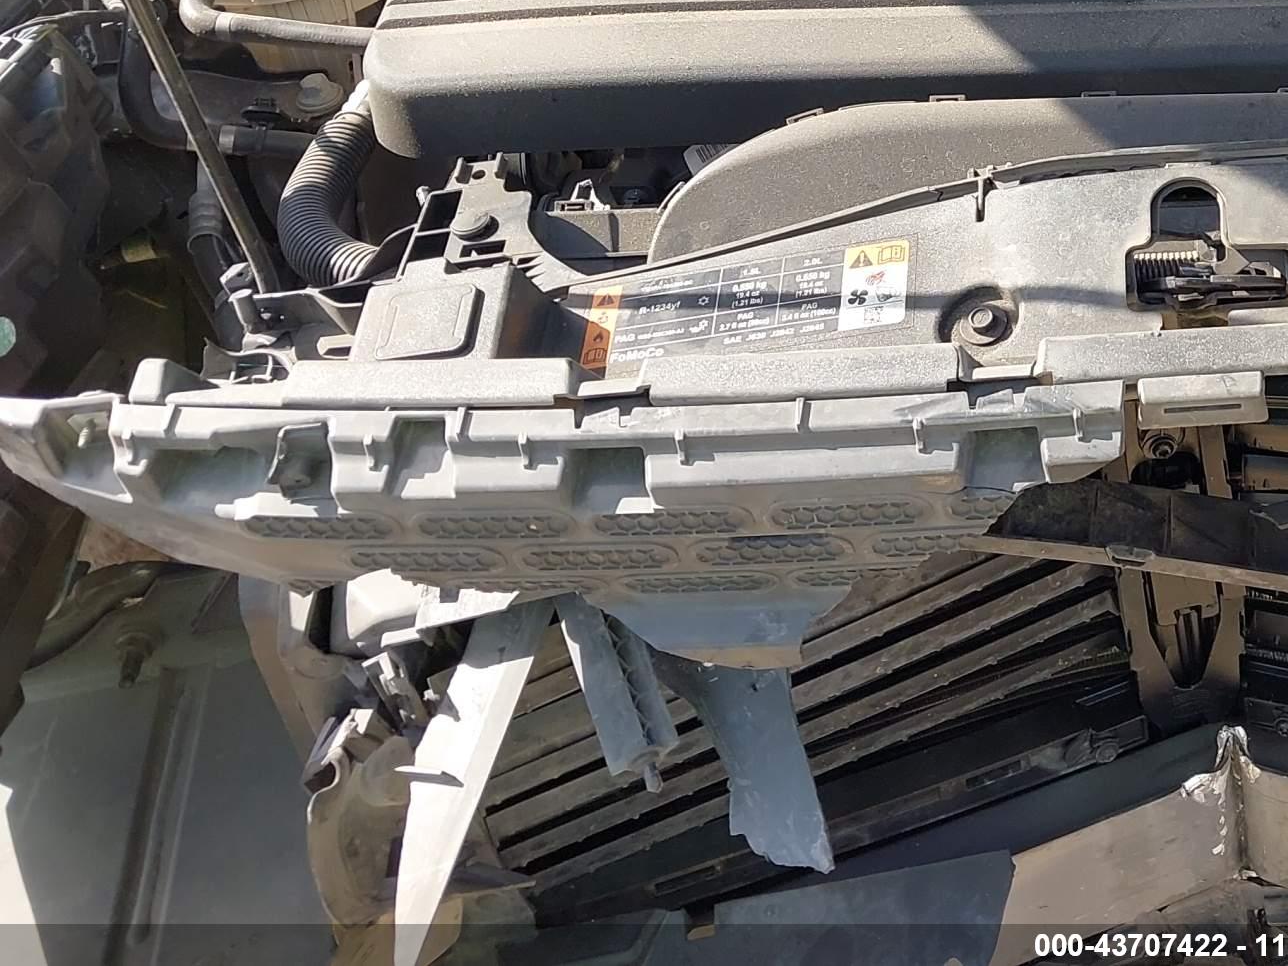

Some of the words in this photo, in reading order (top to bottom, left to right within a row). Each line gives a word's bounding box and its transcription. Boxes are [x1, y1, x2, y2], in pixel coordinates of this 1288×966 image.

[819, 271, 830, 279] kg
[756, 280, 767, 290] kg
[736, 291, 750, 299] 19.4
[639, 300, 682, 315] R-1234yf
[732, 299, 749, 309] (1.21
[750, 297, 763, 305] lbs)
[737, 312, 754, 320] PAG
[614, 333, 635, 344] PAG
[723, 336, 742, 345] SAE
[610, 347, 664, 364] FoMoCo
